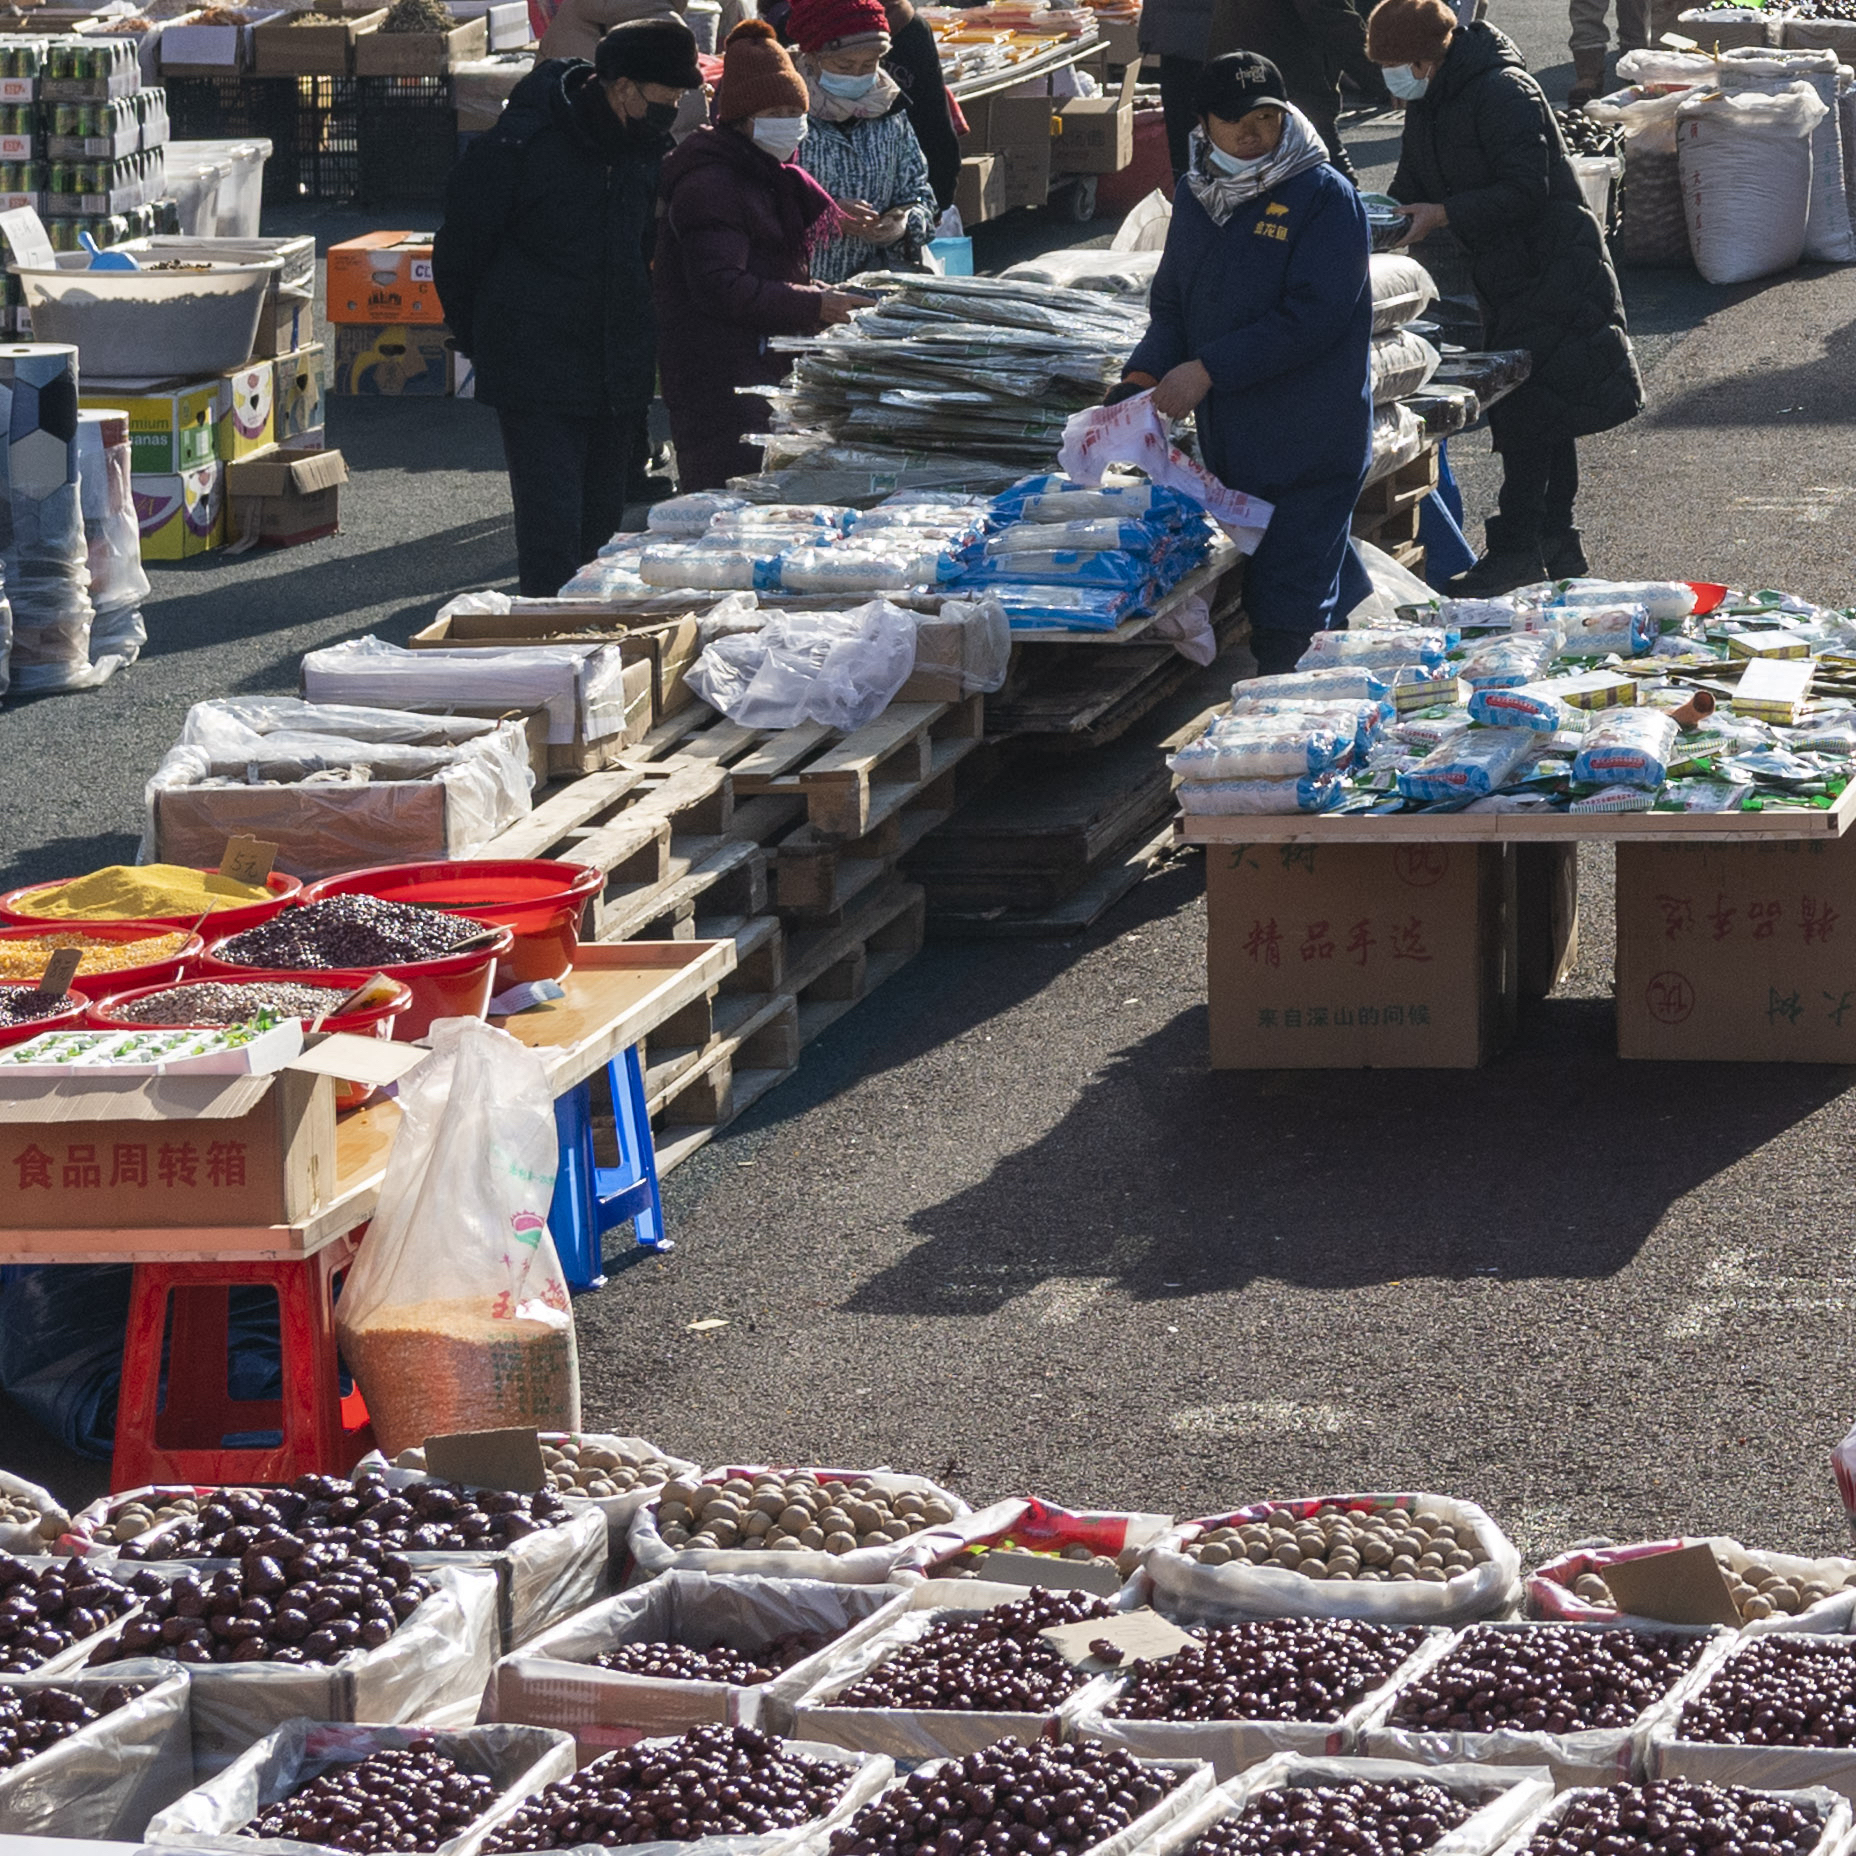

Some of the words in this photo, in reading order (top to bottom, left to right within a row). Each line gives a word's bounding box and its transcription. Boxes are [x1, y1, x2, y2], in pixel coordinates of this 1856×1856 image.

[1244, 916, 1435, 968] 精品手选
[1257, 1002, 1432, 1029] 来自深山的问候
[15, 1144, 247, 1189] 食品周转箱
